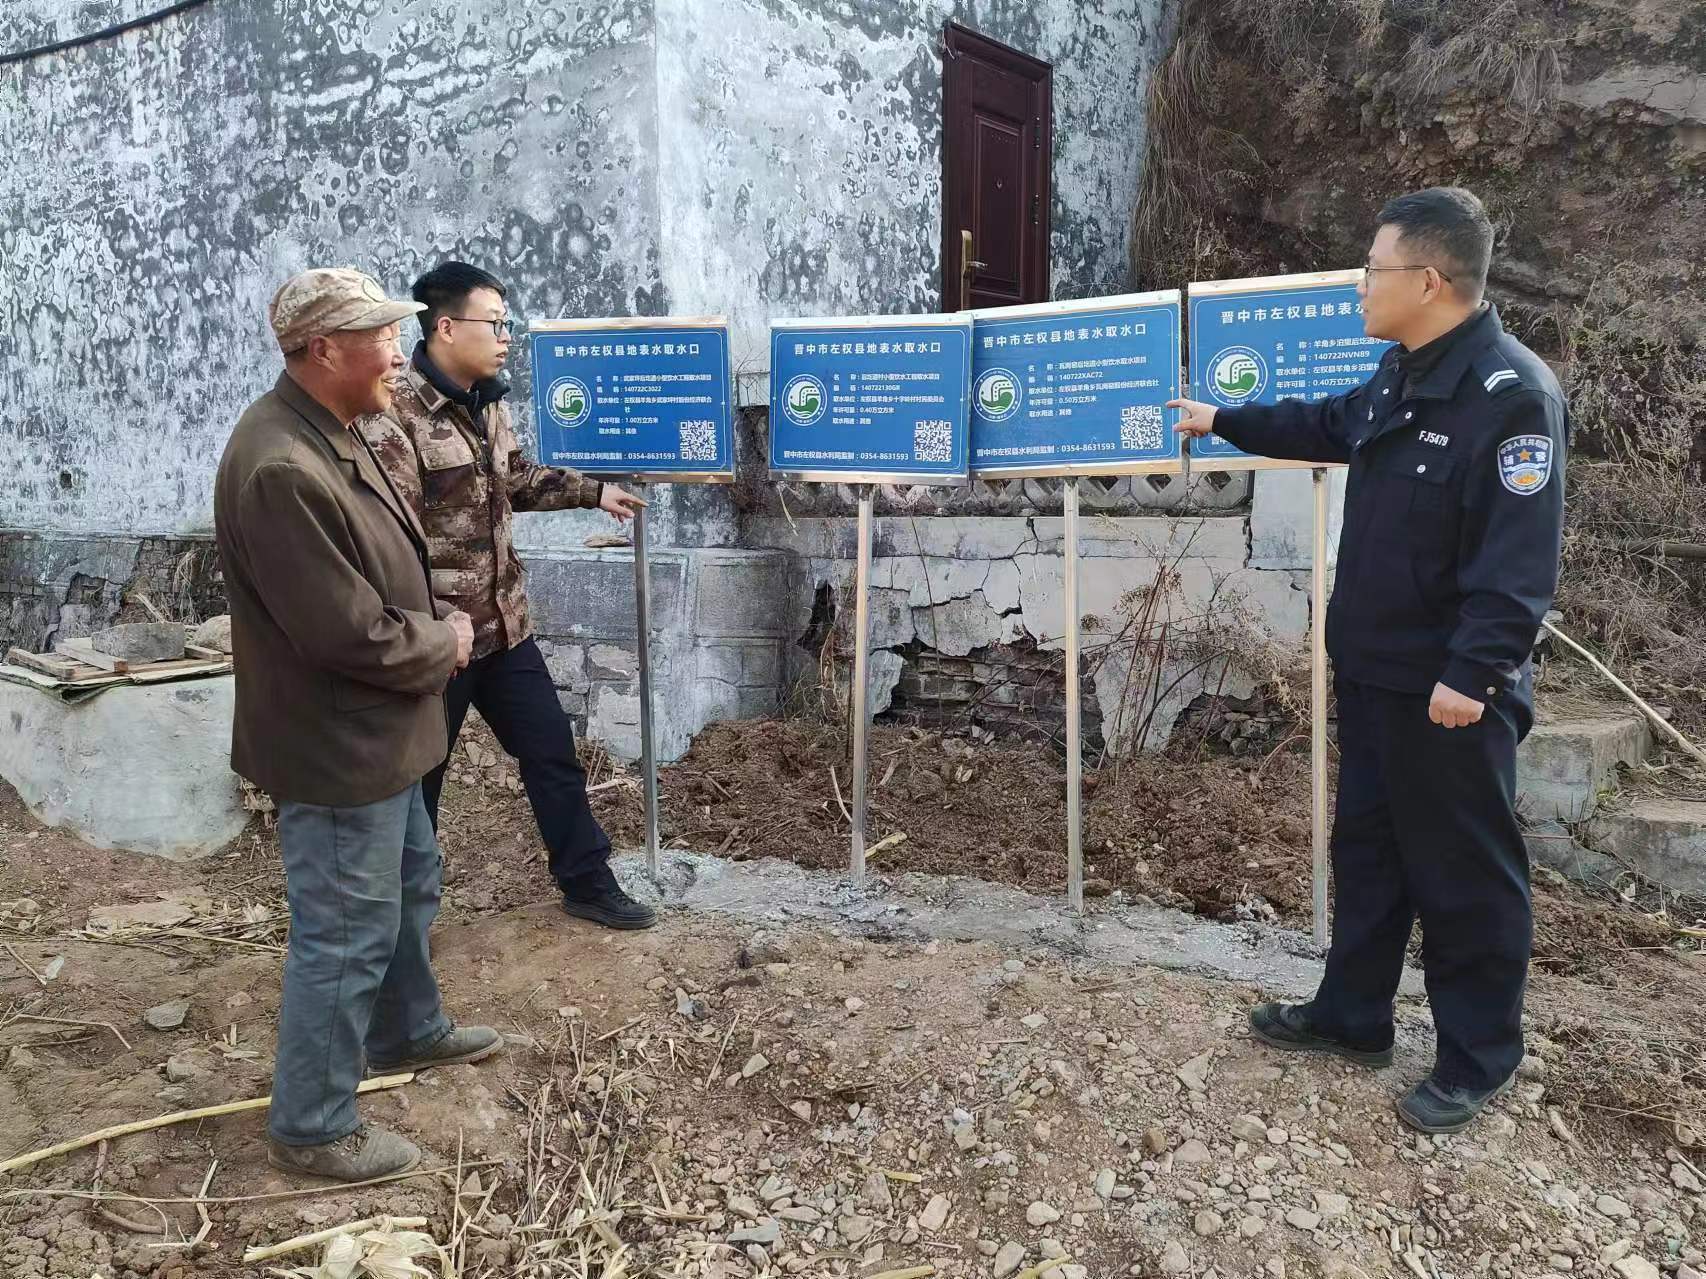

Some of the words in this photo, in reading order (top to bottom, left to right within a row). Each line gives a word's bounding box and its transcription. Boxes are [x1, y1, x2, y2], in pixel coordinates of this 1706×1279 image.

[983, 324, 1146, 348] 晋中市左权县地表水取水口
[554, 344, 699, 357] 晋中市左权县地表水取水口
[795, 342, 941, 355] 晋中市左权县地表水取水口
[1418, 430, 1449, 447] FJ5479
